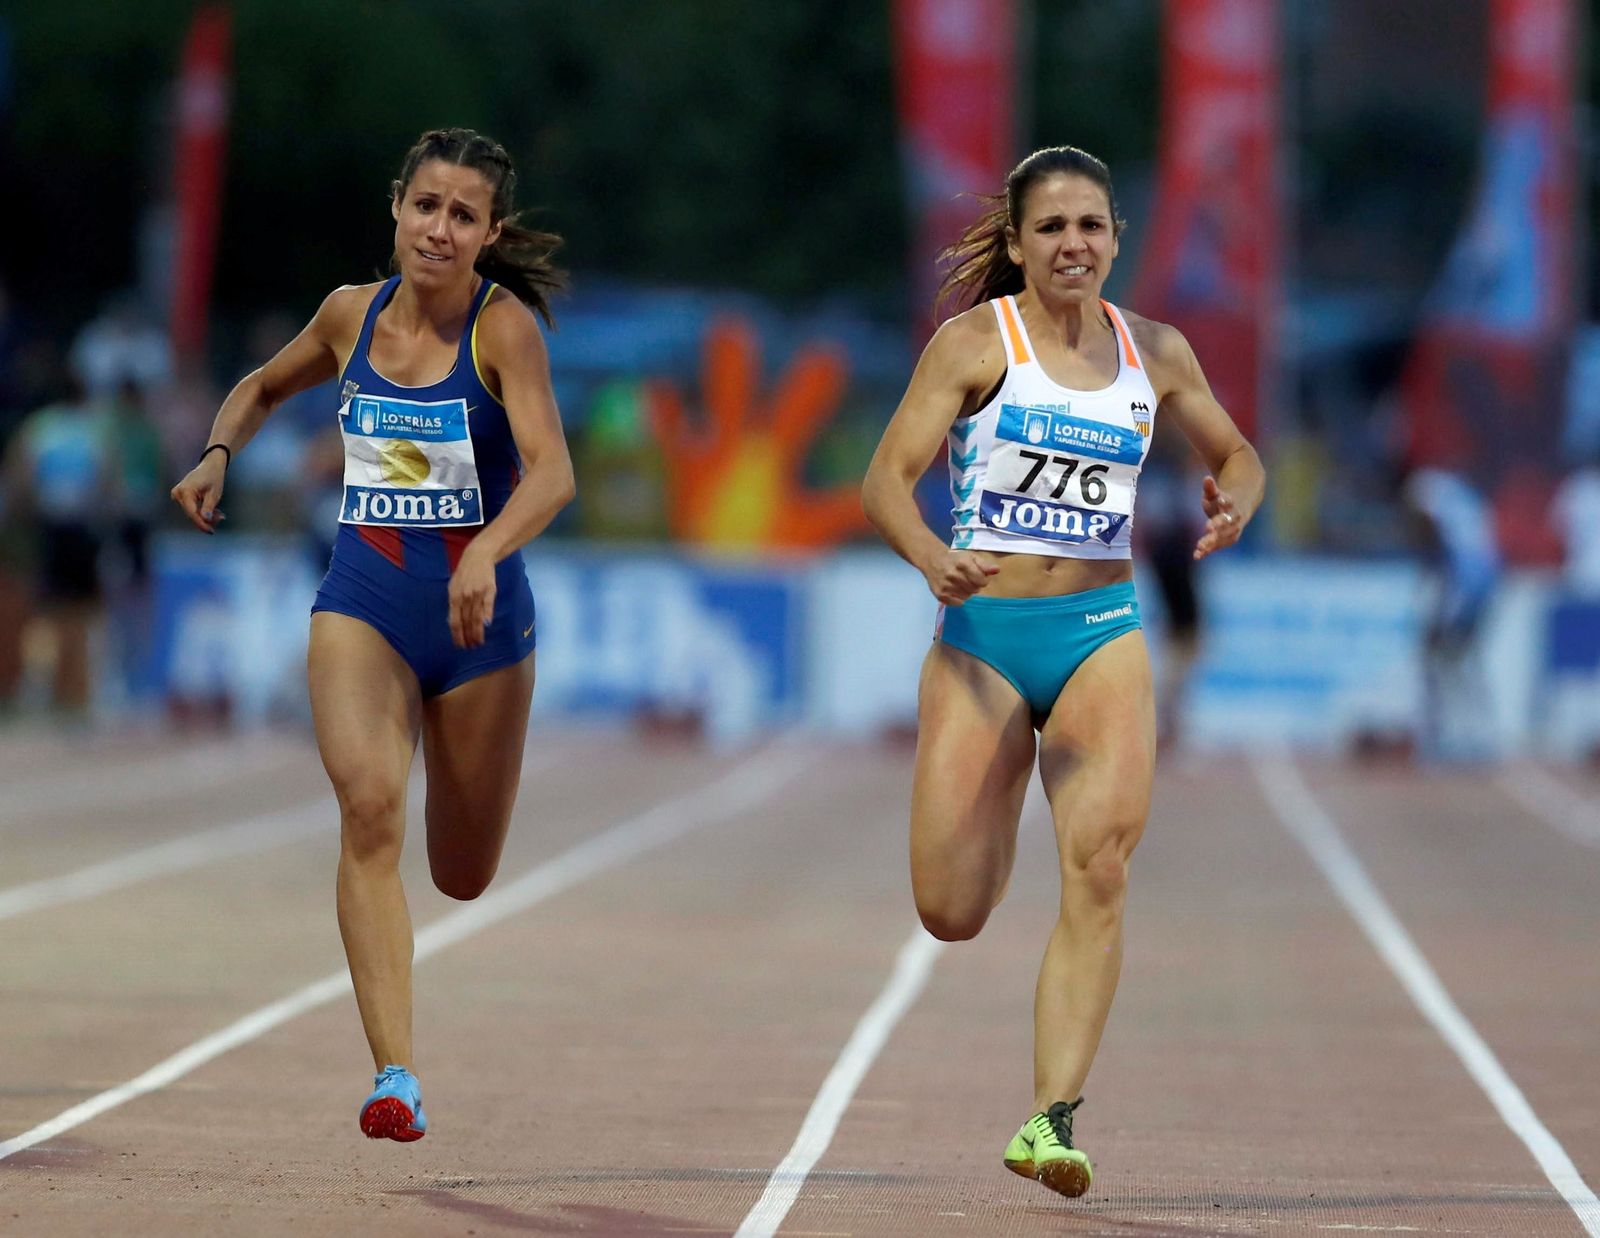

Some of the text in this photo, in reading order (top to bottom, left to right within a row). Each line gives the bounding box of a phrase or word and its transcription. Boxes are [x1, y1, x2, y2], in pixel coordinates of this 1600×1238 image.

[382, 412, 442, 428] LOTERÍAS
[1054, 423, 1122, 447] LOTERÍAS
[1015, 449, 1110, 506] 776
[1085, 603, 1132, 624] hummel
